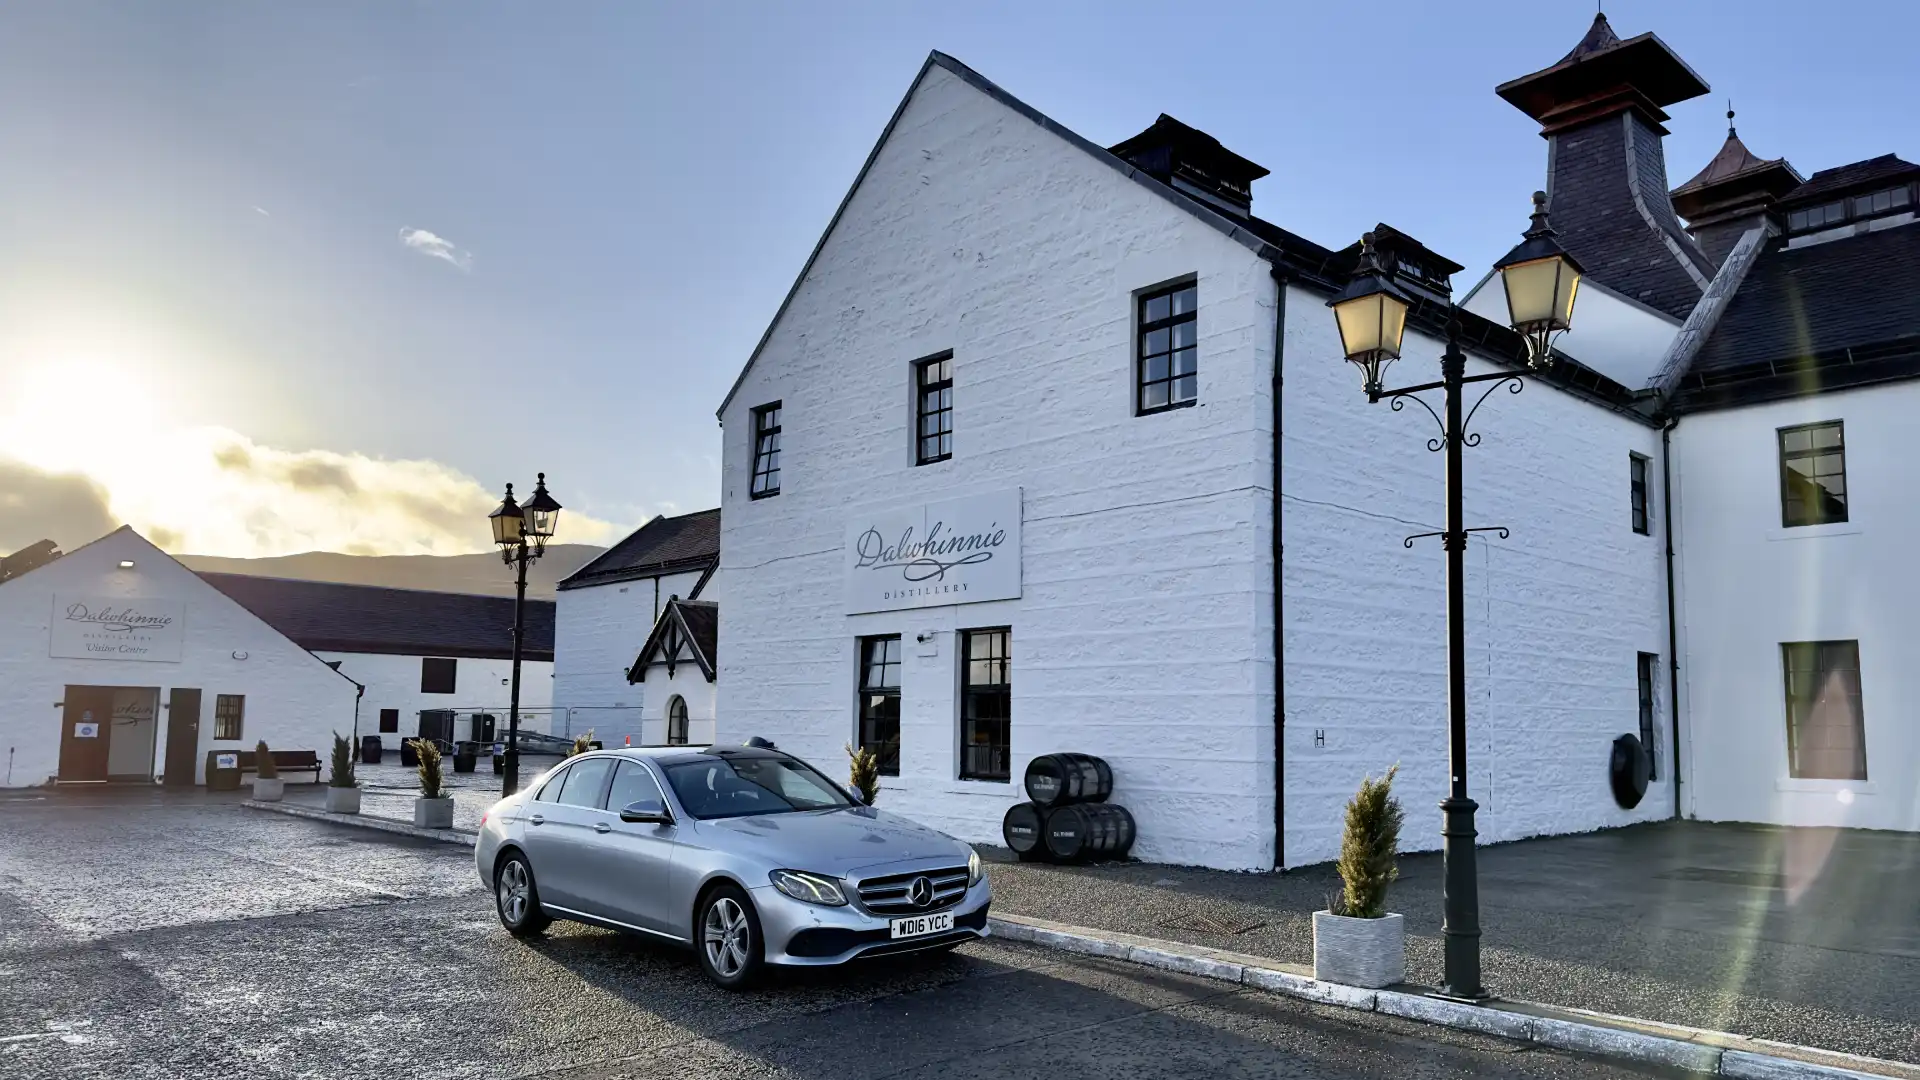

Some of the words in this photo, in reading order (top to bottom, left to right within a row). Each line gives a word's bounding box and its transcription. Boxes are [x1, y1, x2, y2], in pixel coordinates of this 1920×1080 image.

[855, 521, 1006, 570] Dalwhinnie
[884, 583, 969, 600] DISTILLERY
[66, 602, 172, 625] Dalwhinnie
[86, 643, 116, 653] Visitor
[118, 644, 148, 654] Centre
[899, 918, 925, 936] WD16
[928, 914, 948, 931] YCC
